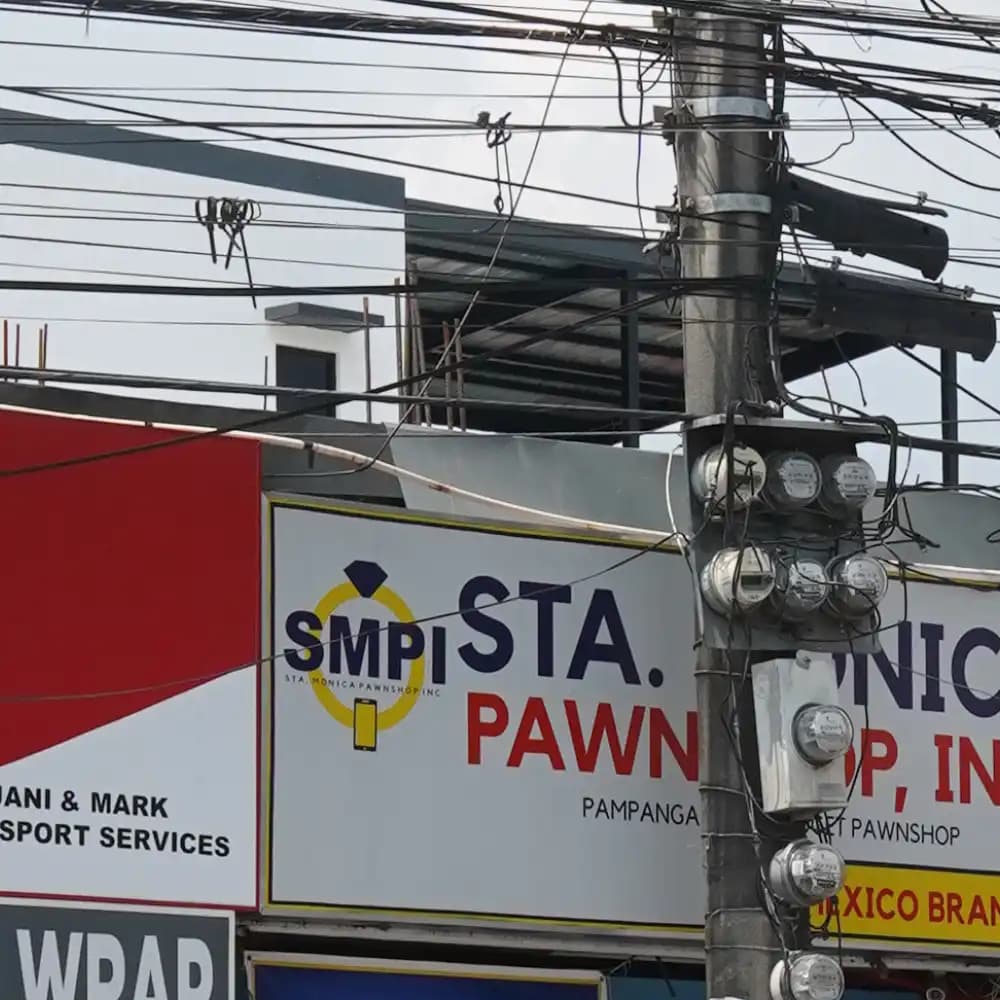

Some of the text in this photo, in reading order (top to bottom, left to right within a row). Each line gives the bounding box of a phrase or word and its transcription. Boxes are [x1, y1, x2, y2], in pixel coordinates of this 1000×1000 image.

[283, 610, 446, 685] SMPI
[457, 575, 664, 688] STA.
[312, 677, 355, 688] MONICA
[0, 785, 168, 818] ANI & MARK
[582, 797, 700, 827] PAMPANGA
[851, 817, 960, 845] PAWNSHOP
[0, 820, 230, 857] SPORT SERVICES
